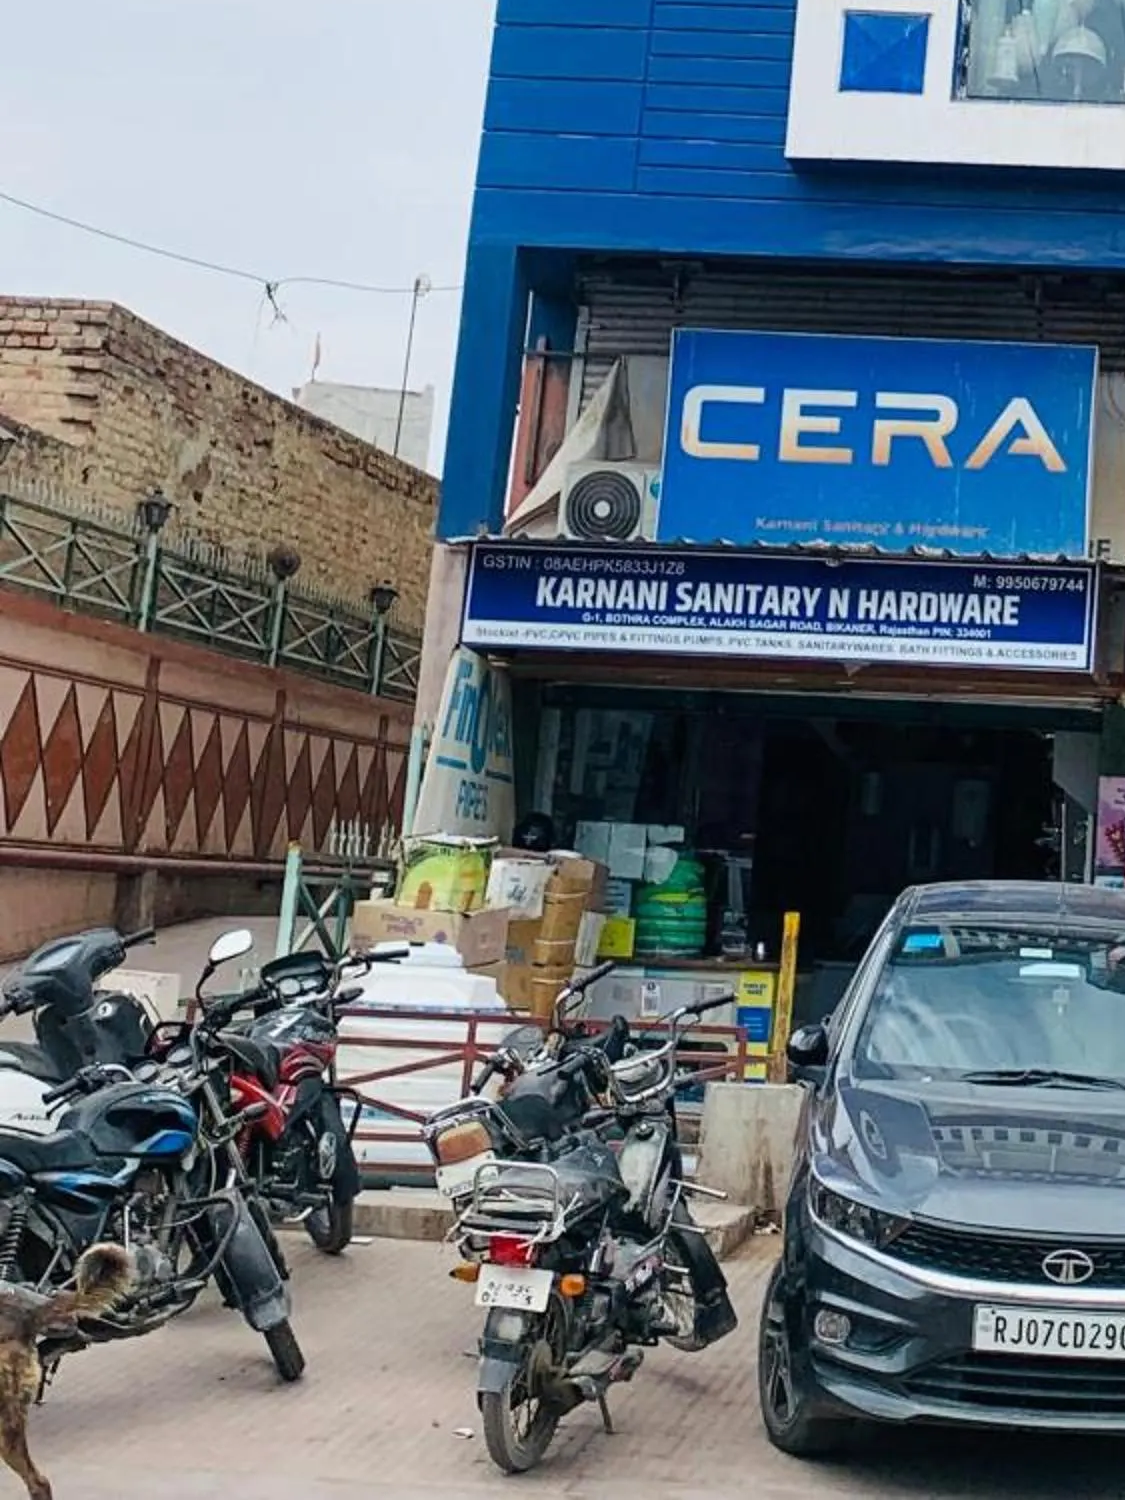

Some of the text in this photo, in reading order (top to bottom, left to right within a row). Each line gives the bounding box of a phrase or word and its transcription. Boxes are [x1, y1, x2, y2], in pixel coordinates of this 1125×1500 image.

[680, 385, 1068, 473] CERA
[483, 554, 531, 569] GSTIN
[973, 574, 1085, 592] M: 9950679744
[536, 576, 1021, 627] KARNANI SANITARY N HARDWARE
[605, 613, 650, 626] BOTHRA
[709, 617, 747, 629] ALAKH
[749, 619, 787, 630] SAGAR
[879, 623, 930, 637] Rajasthan
[956, 626, 992, 639] 334001
